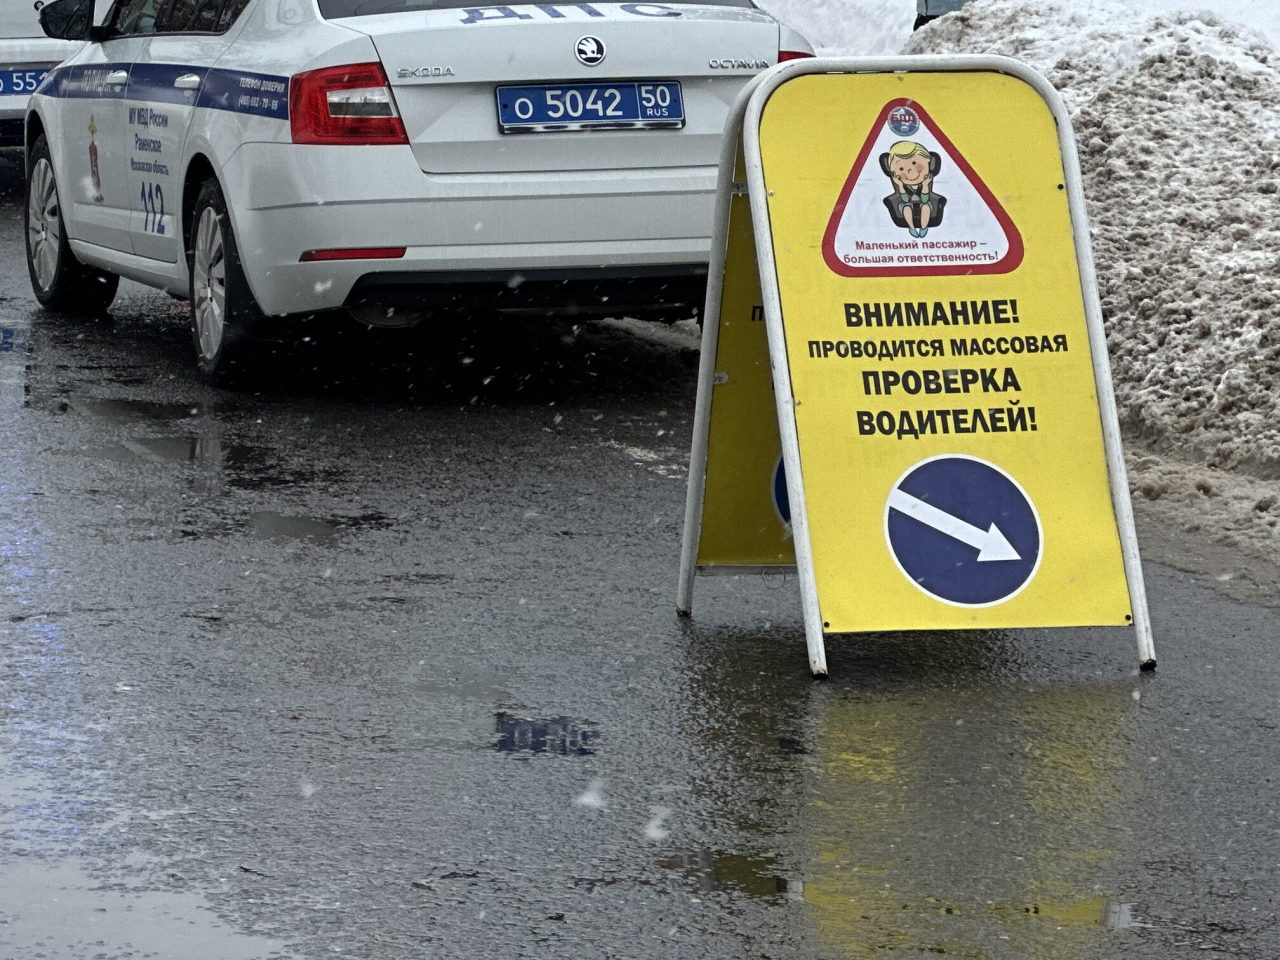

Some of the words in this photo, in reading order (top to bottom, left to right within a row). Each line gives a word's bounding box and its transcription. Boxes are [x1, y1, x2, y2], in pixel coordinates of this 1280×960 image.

[459, 2, 682, 25] ДПС
[397, 65, 456, 79] SKODA
[708, 58, 770, 70] OCTAVIA
[545, 88, 624, 118] 5042
[641, 85, 672, 108] 50
[646, 107, 669, 118] RUS
[136, 107, 149, 128] МВД
[149, 108, 169, 128] России
[134, 132, 162, 153] Раменское
[140, 181, 166, 235] 112
[855, 240, 919, 251] Маленький
[921, 240, 978, 251] пассажир
[843, 253, 894, 264] большая
[897, 251, 999, 263] ответственность!
[843, 299, 1020, 328] ВНИМАНИЕ!
[808, 338, 945, 361] ПРОВОДИТСЯ
[949, 334, 1069, 357] МАССОВАЯ
[861, 367, 1022, 395] ПРОВЕРКА
[856, 399, 1038, 440] ВОДИТЕЛЕЙ!
